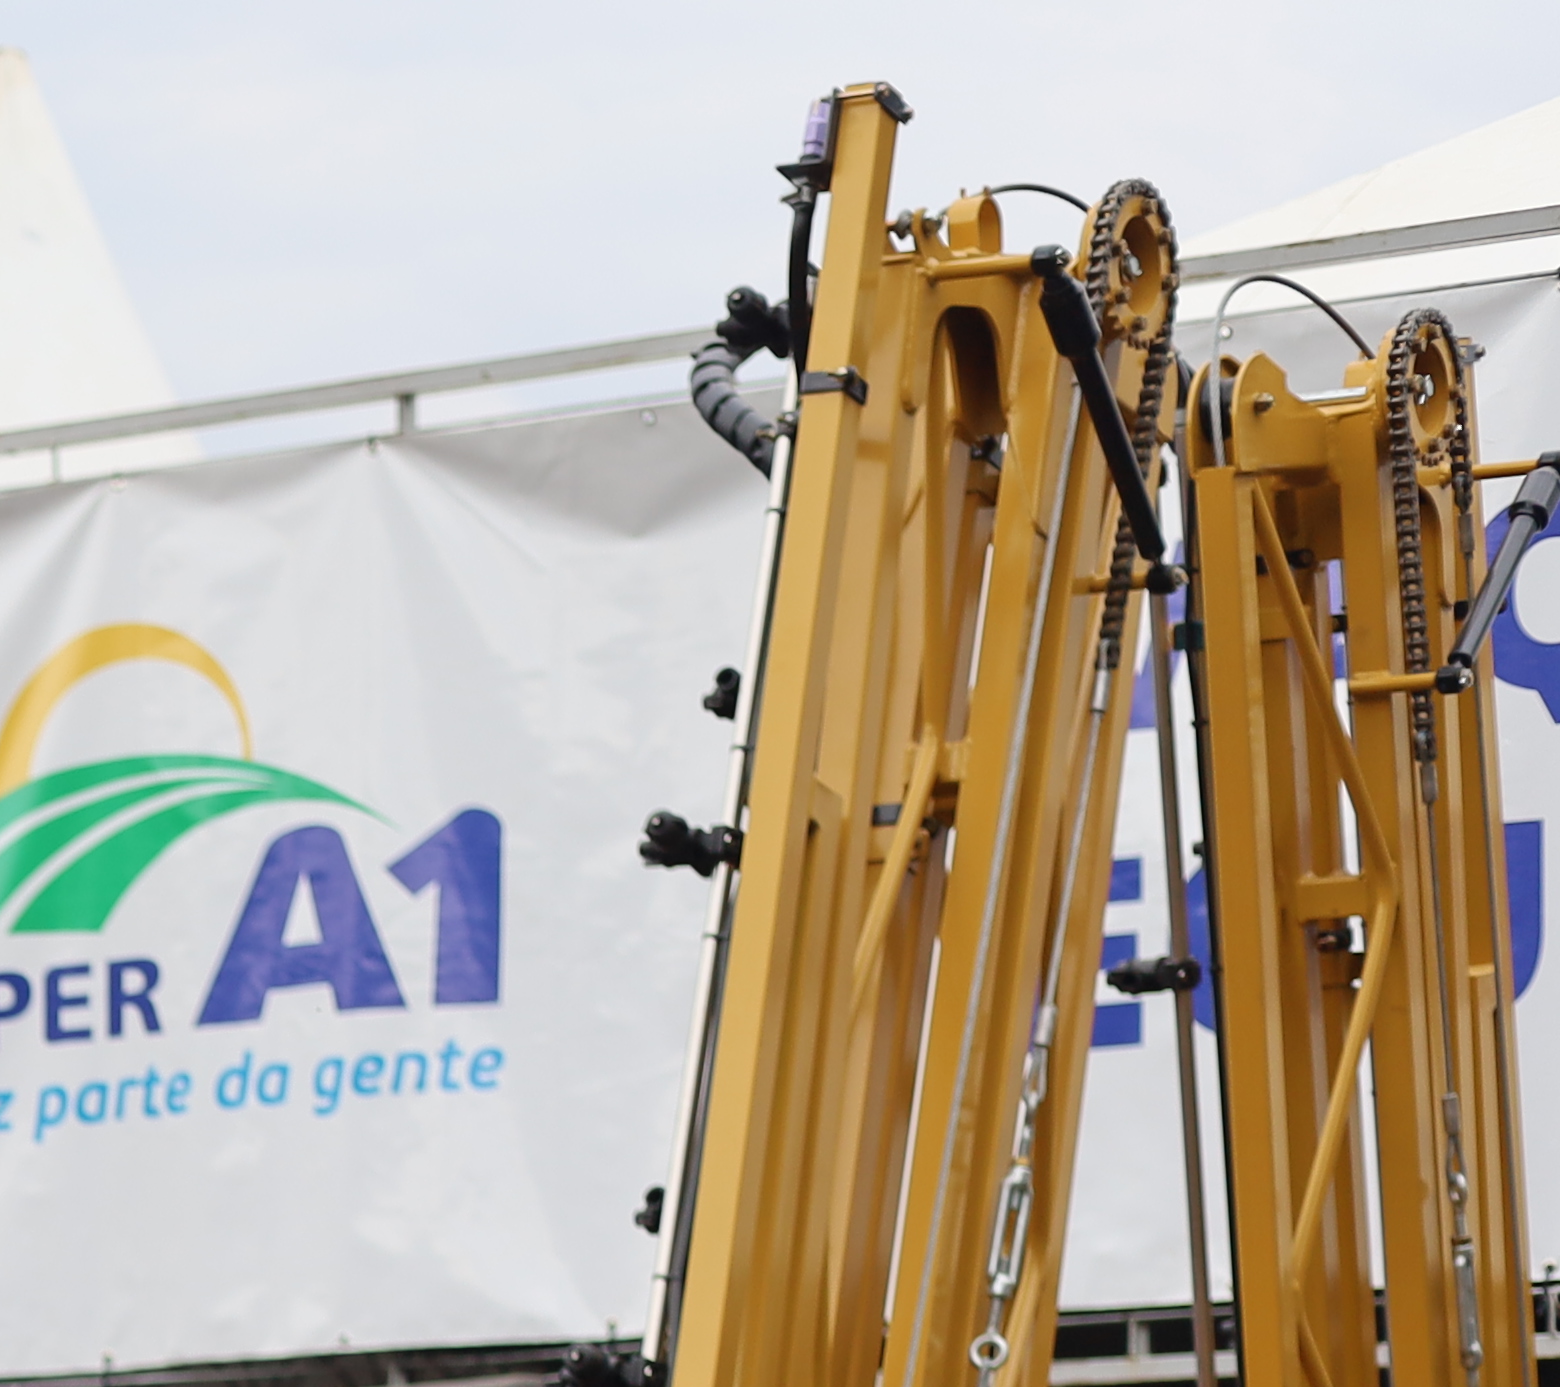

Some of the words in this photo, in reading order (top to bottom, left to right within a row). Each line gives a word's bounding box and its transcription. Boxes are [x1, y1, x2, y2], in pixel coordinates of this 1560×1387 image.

[194, 807, 504, 1027] A1
[35, 1063, 191, 1144] parte
[214, 1049, 290, 1112] da
[311, 1038, 505, 1118] gente
